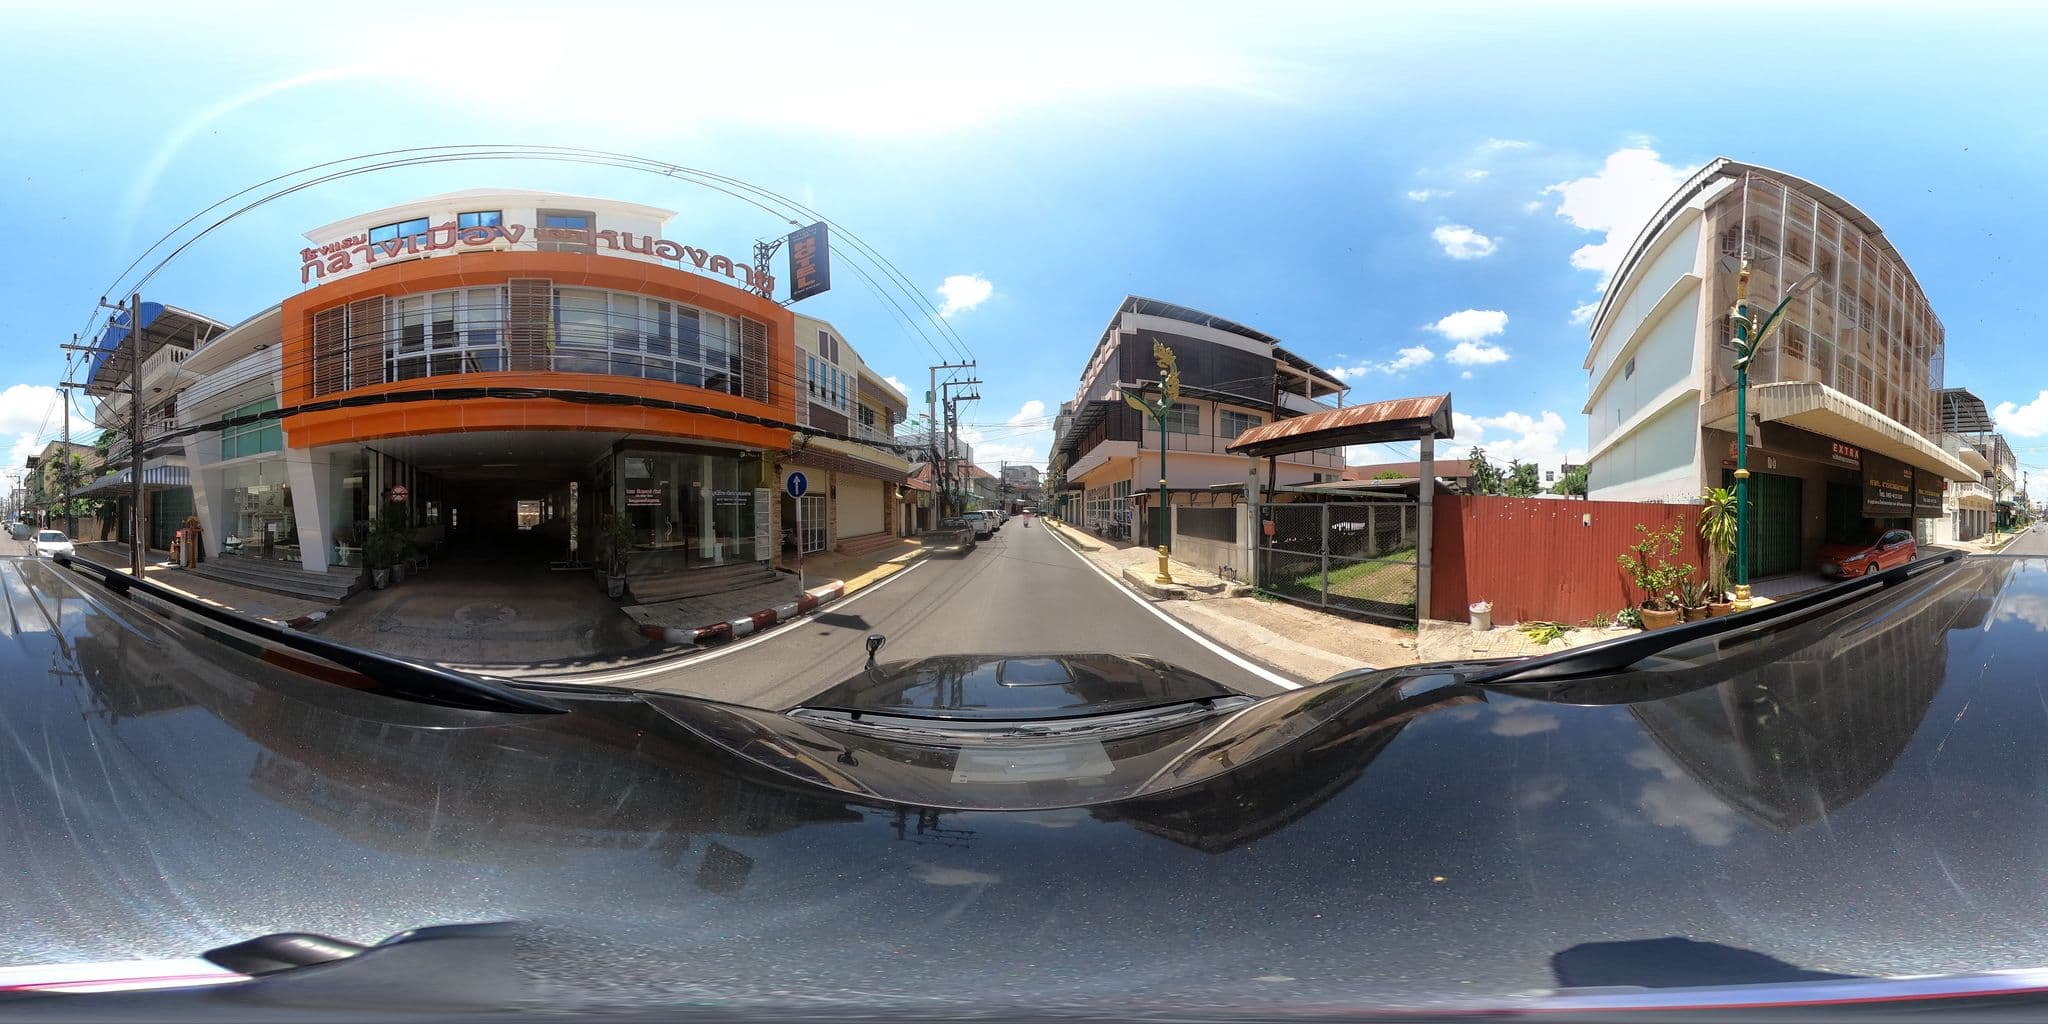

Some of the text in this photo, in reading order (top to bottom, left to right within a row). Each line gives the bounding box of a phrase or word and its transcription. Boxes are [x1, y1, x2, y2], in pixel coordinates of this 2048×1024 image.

[300, 233, 367, 263] โรงแรม
[300, 221, 775, 293] กลางเมือง หนองคาย
[793, 236, 816, 289] HOTEL
[1833, 442, 1859, 459] EXTRA
